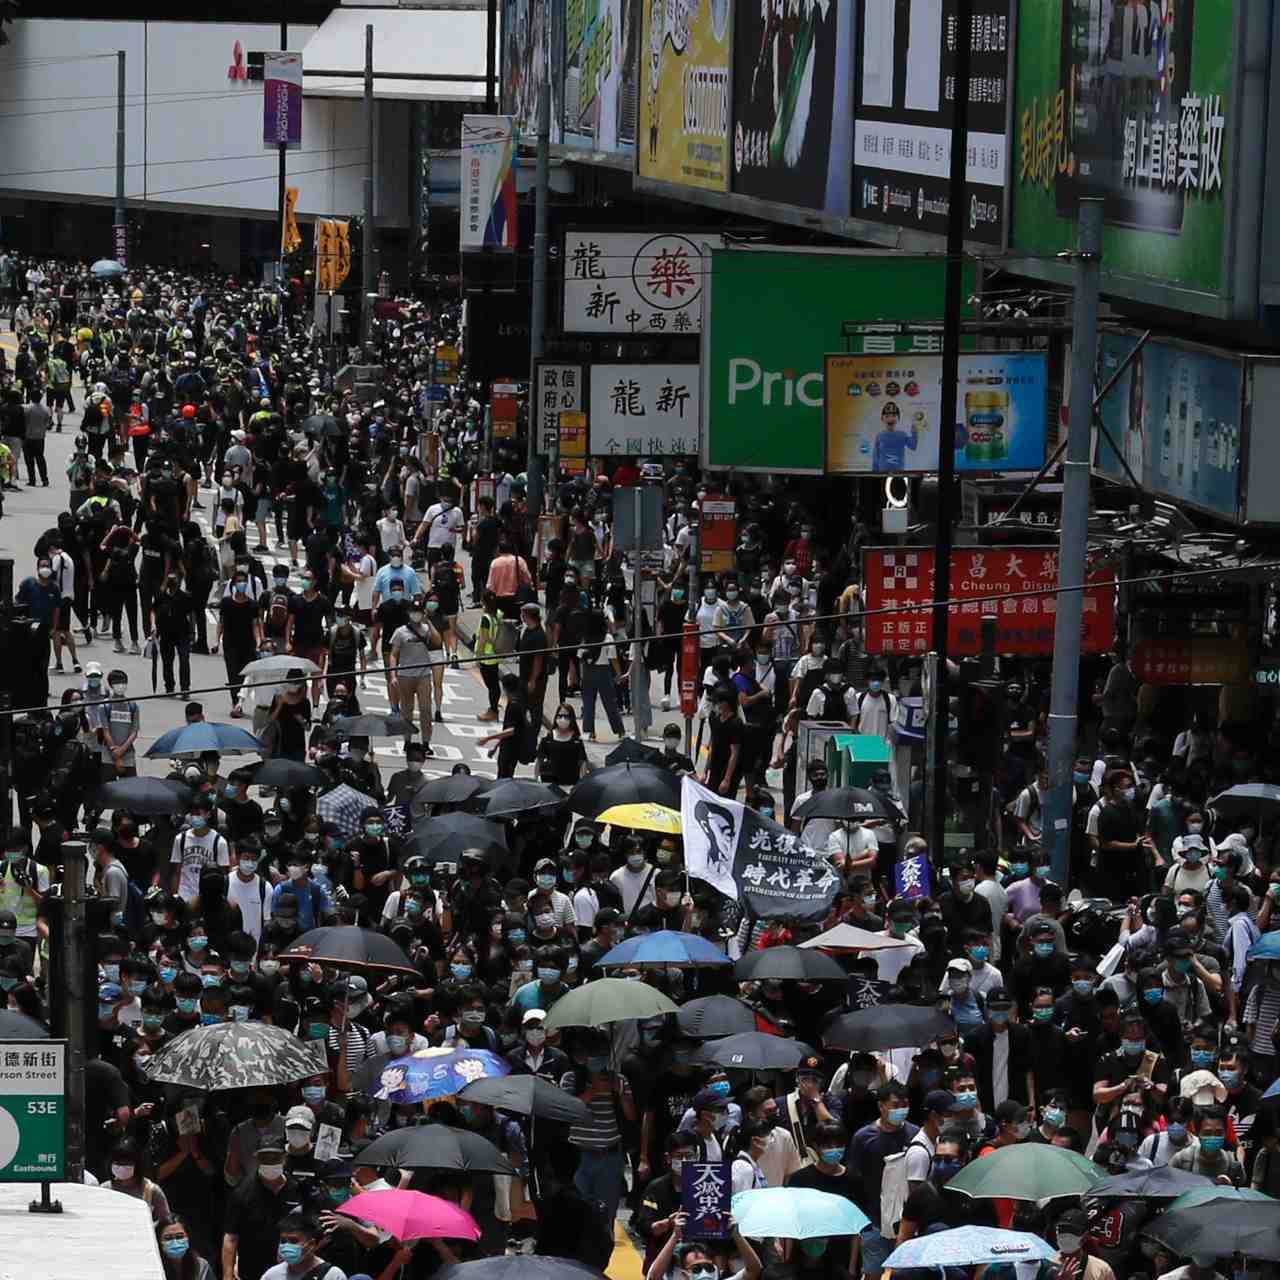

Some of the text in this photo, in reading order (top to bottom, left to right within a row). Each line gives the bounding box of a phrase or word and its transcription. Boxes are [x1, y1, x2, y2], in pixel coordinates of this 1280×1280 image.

[646, 246, 695, 299] 藥
[625, 308, 703, 333] 中西藥
[25, 1070, 57, 1080] Street
[27, 1101, 57, 1115] 53E
